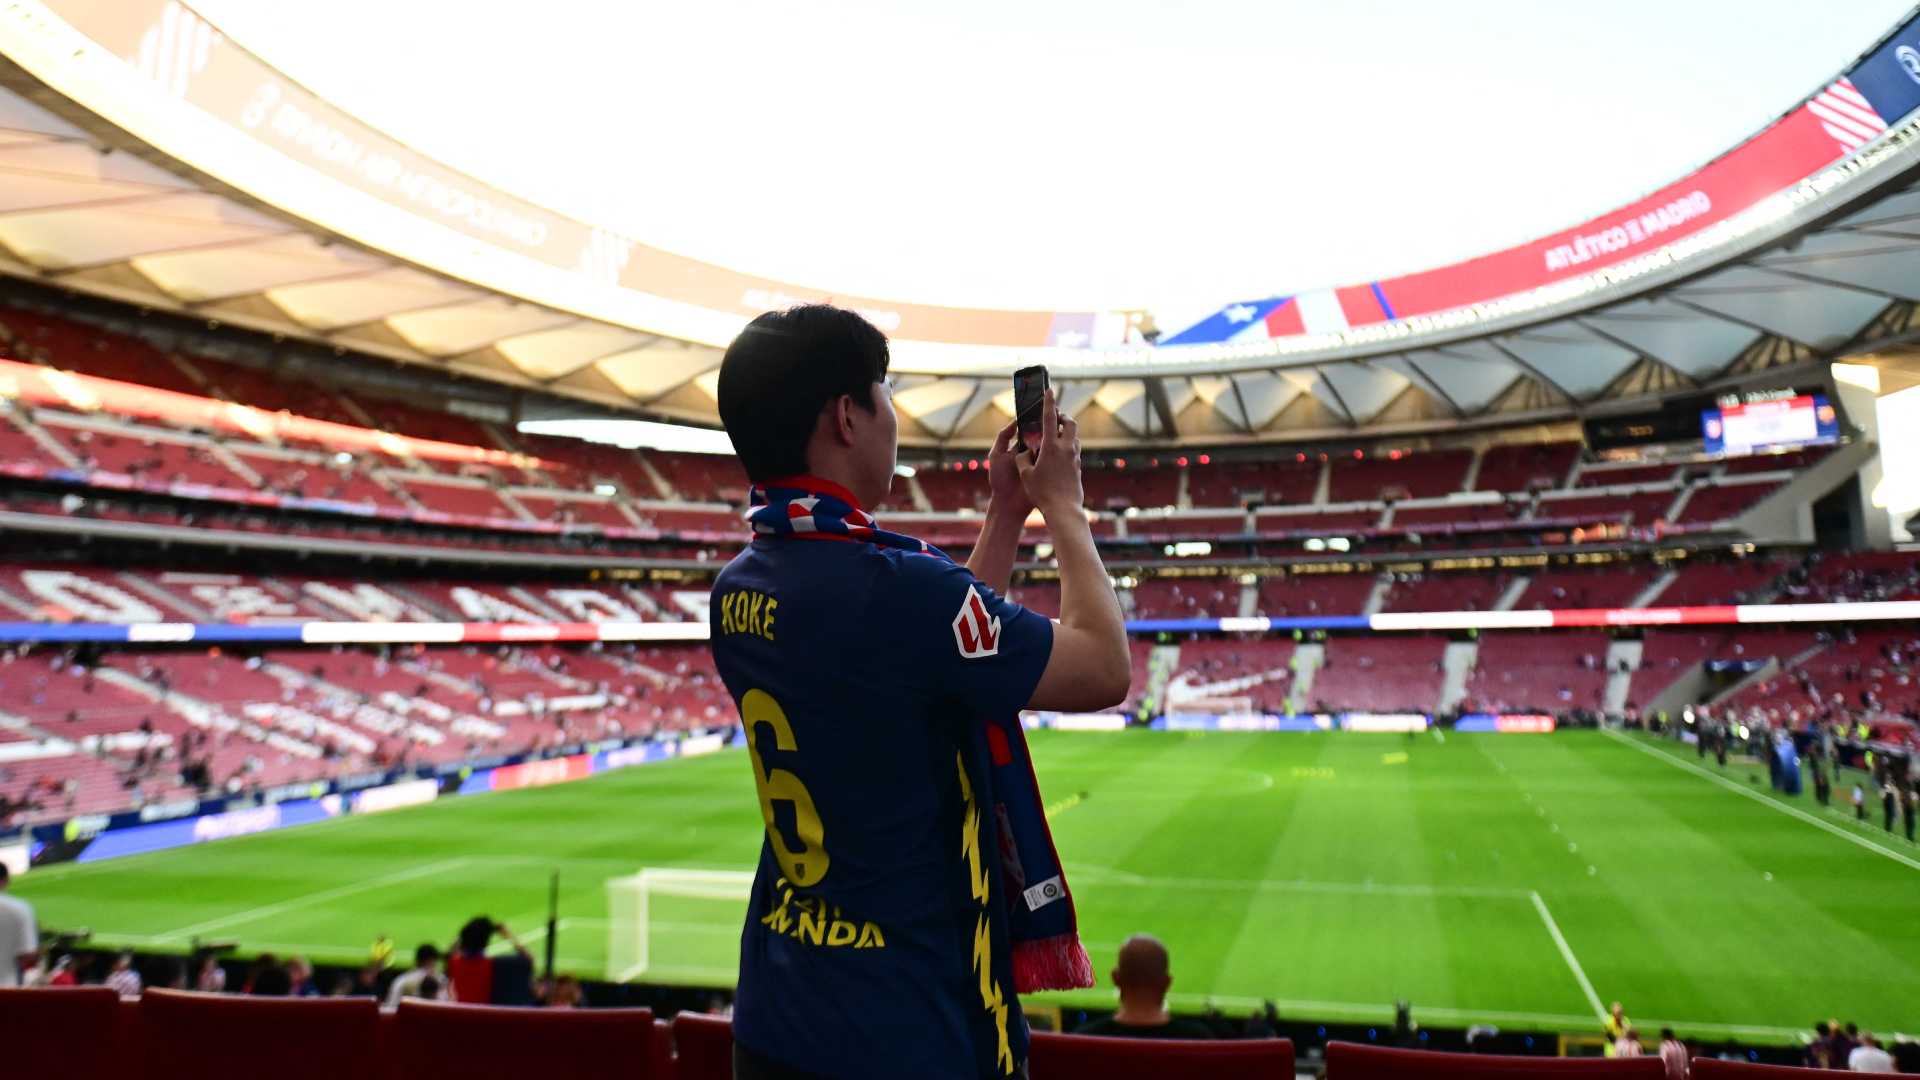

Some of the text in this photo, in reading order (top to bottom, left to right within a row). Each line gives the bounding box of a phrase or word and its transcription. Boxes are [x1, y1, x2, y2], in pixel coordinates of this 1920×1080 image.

[1639, 190, 1711, 236] MADRID
[721, 590, 778, 641] KOKE
[742, 688, 830, 887] 6
